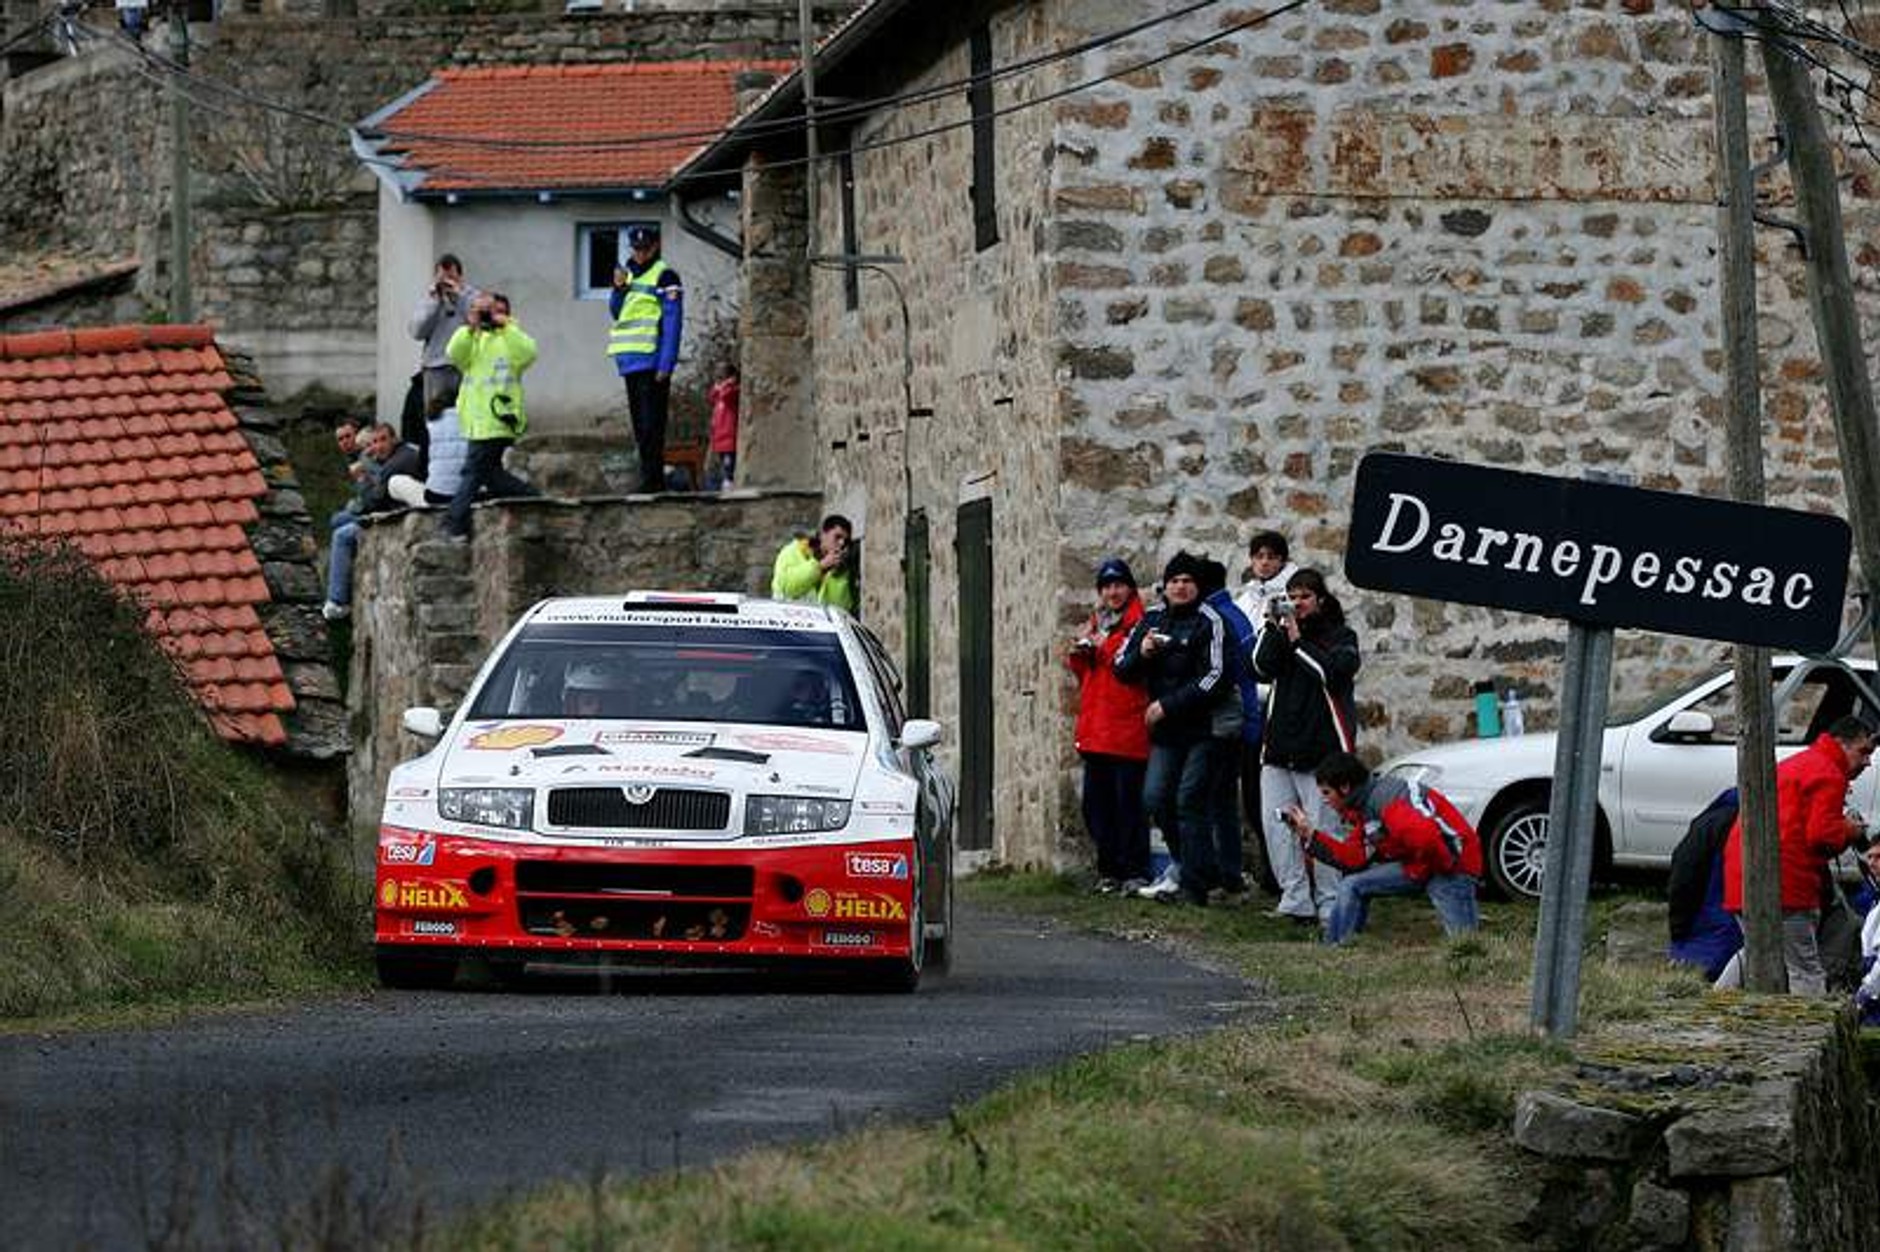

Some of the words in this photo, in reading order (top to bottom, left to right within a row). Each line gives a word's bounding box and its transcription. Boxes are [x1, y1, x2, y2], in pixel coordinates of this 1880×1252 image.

[1372, 492, 1814, 610] Darnepessac
[851, 855, 890, 873] tesa
[401, 888, 469, 908] HELIX
[834, 898, 907, 920] HELIX
